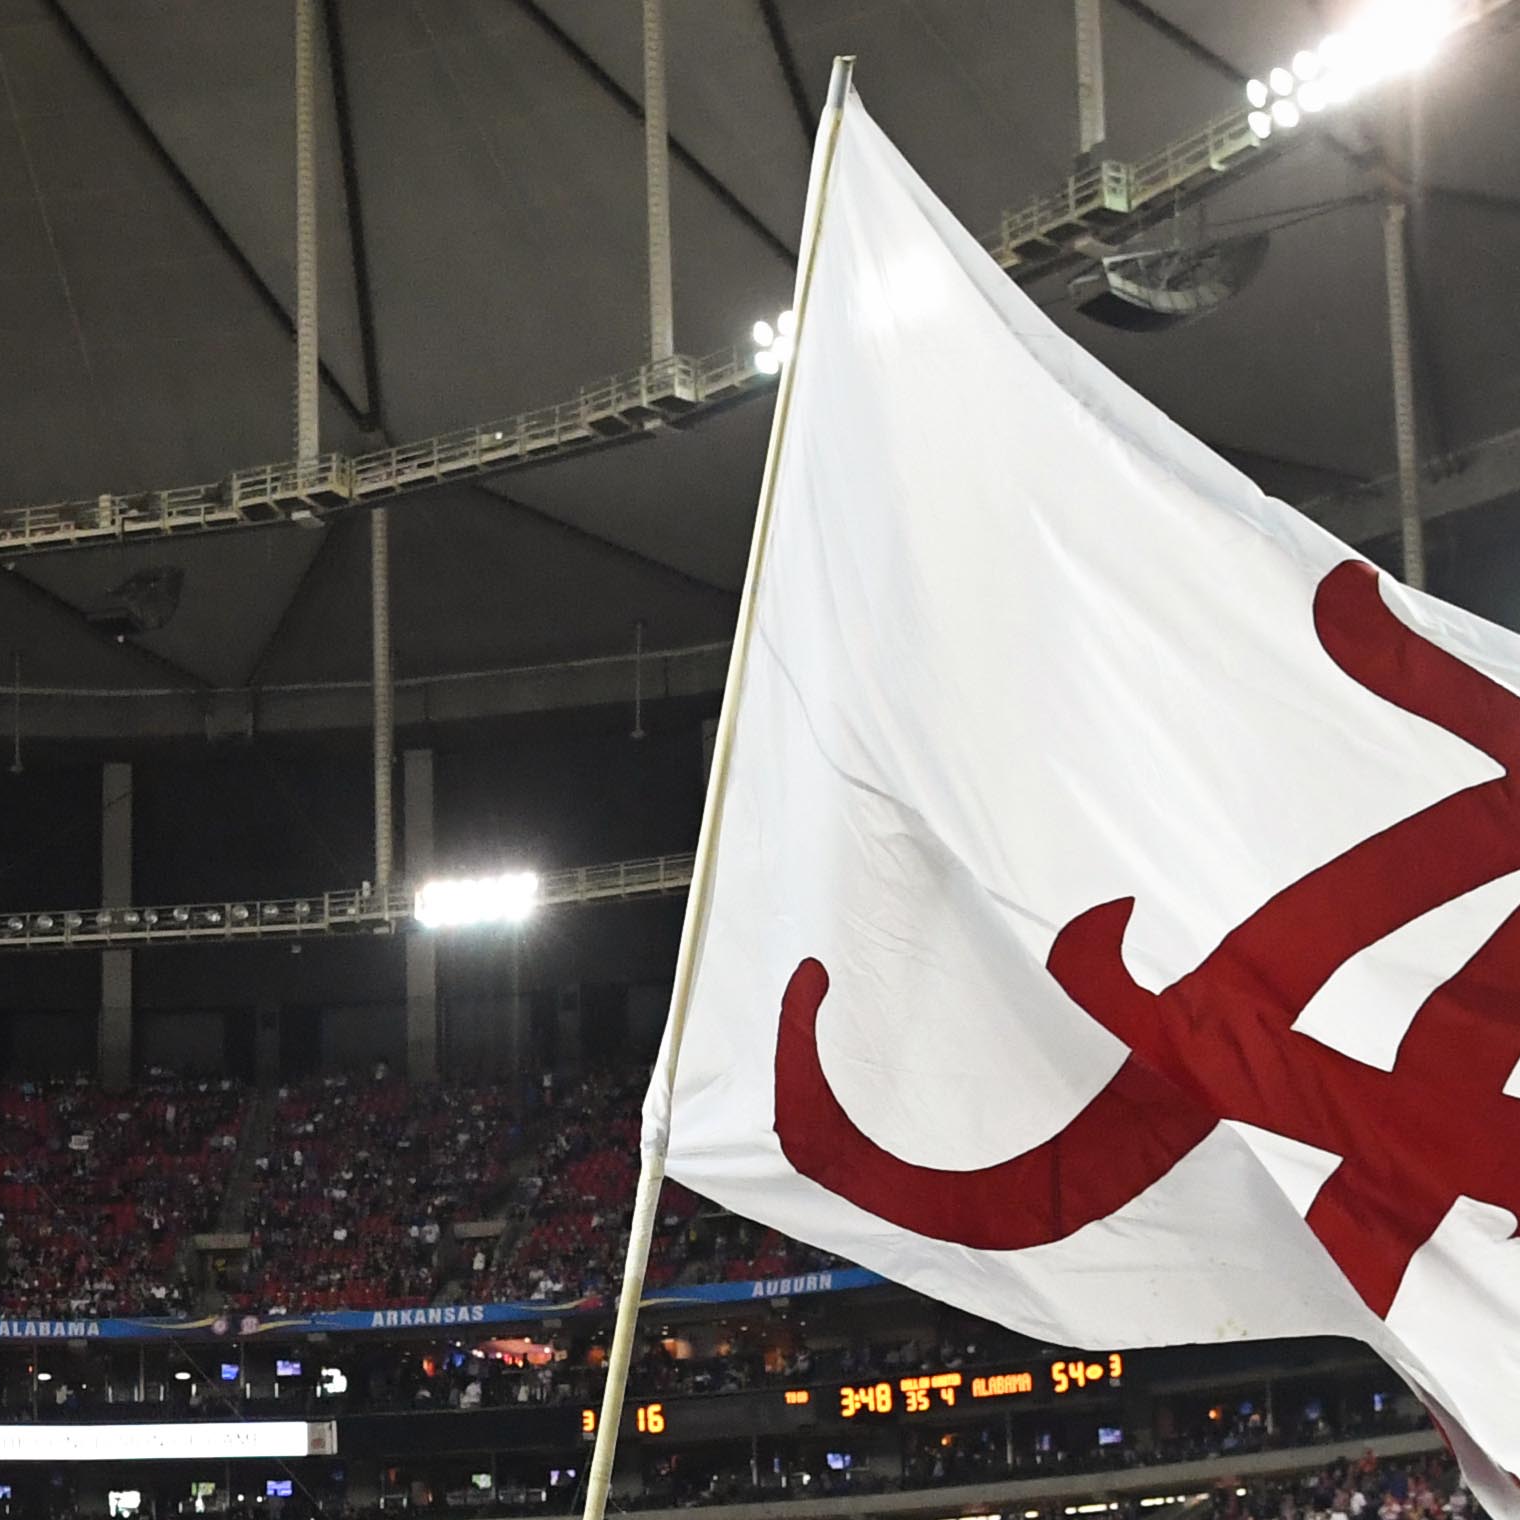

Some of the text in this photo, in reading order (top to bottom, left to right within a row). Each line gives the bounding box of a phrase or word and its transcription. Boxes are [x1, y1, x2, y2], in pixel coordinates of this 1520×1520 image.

[751, 1274, 833, 1298] AUBURN
[371, 1305, 485, 1328] ARKANSAS
[971, 1372, 1032, 1398] ALABAMA
[1051, 1360, 1086, 1393] 54
[1108, 1353, 1122, 1378] 3
[840, 1382, 892, 1418] 3:48
[905, 1387, 956, 1412] 35 4
[582, 1409, 595, 1432] 3
